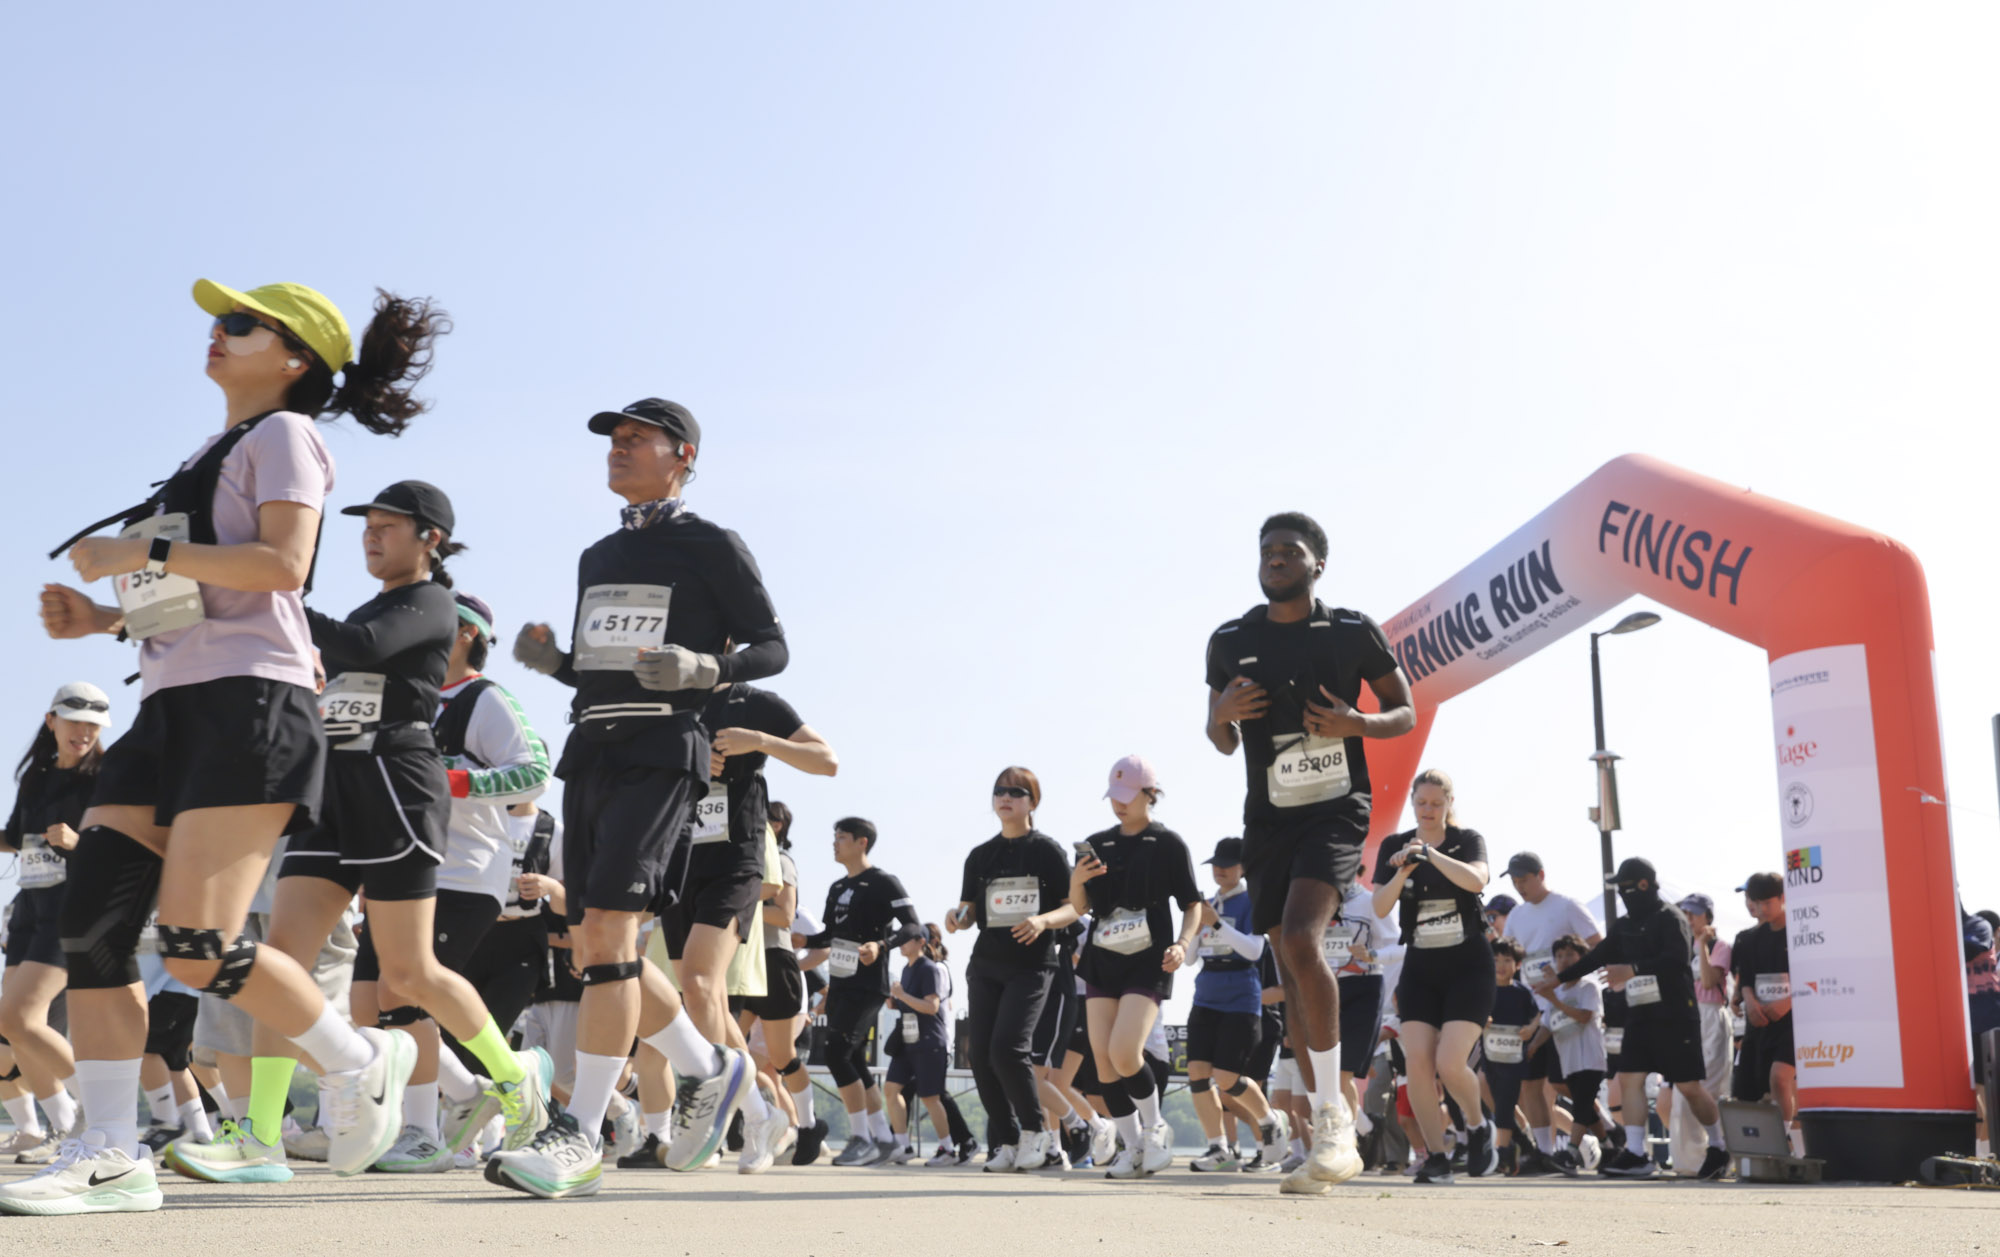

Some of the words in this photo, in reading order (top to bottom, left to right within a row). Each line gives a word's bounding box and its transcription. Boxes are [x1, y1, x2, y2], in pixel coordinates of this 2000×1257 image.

[1599, 500, 1752, 605] FINISH
[1489, 538, 1564, 630] RUN
[604, 614, 664, 632] 5177
[1503, 618, 1548, 644] Running
[1538, 594, 1582, 623] Festival
[328, 700, 377, 717] 5763
[1281, 763, 1292, 774] M
[1787, 866, 1823, 888] KIND
[1006, 893, 1038, 905] 5747
[1792, 904, 1820, 921] TOUS
[1112, 917, 1144, 934] 5757
[1793, 931, 1825, 951] JOURS
